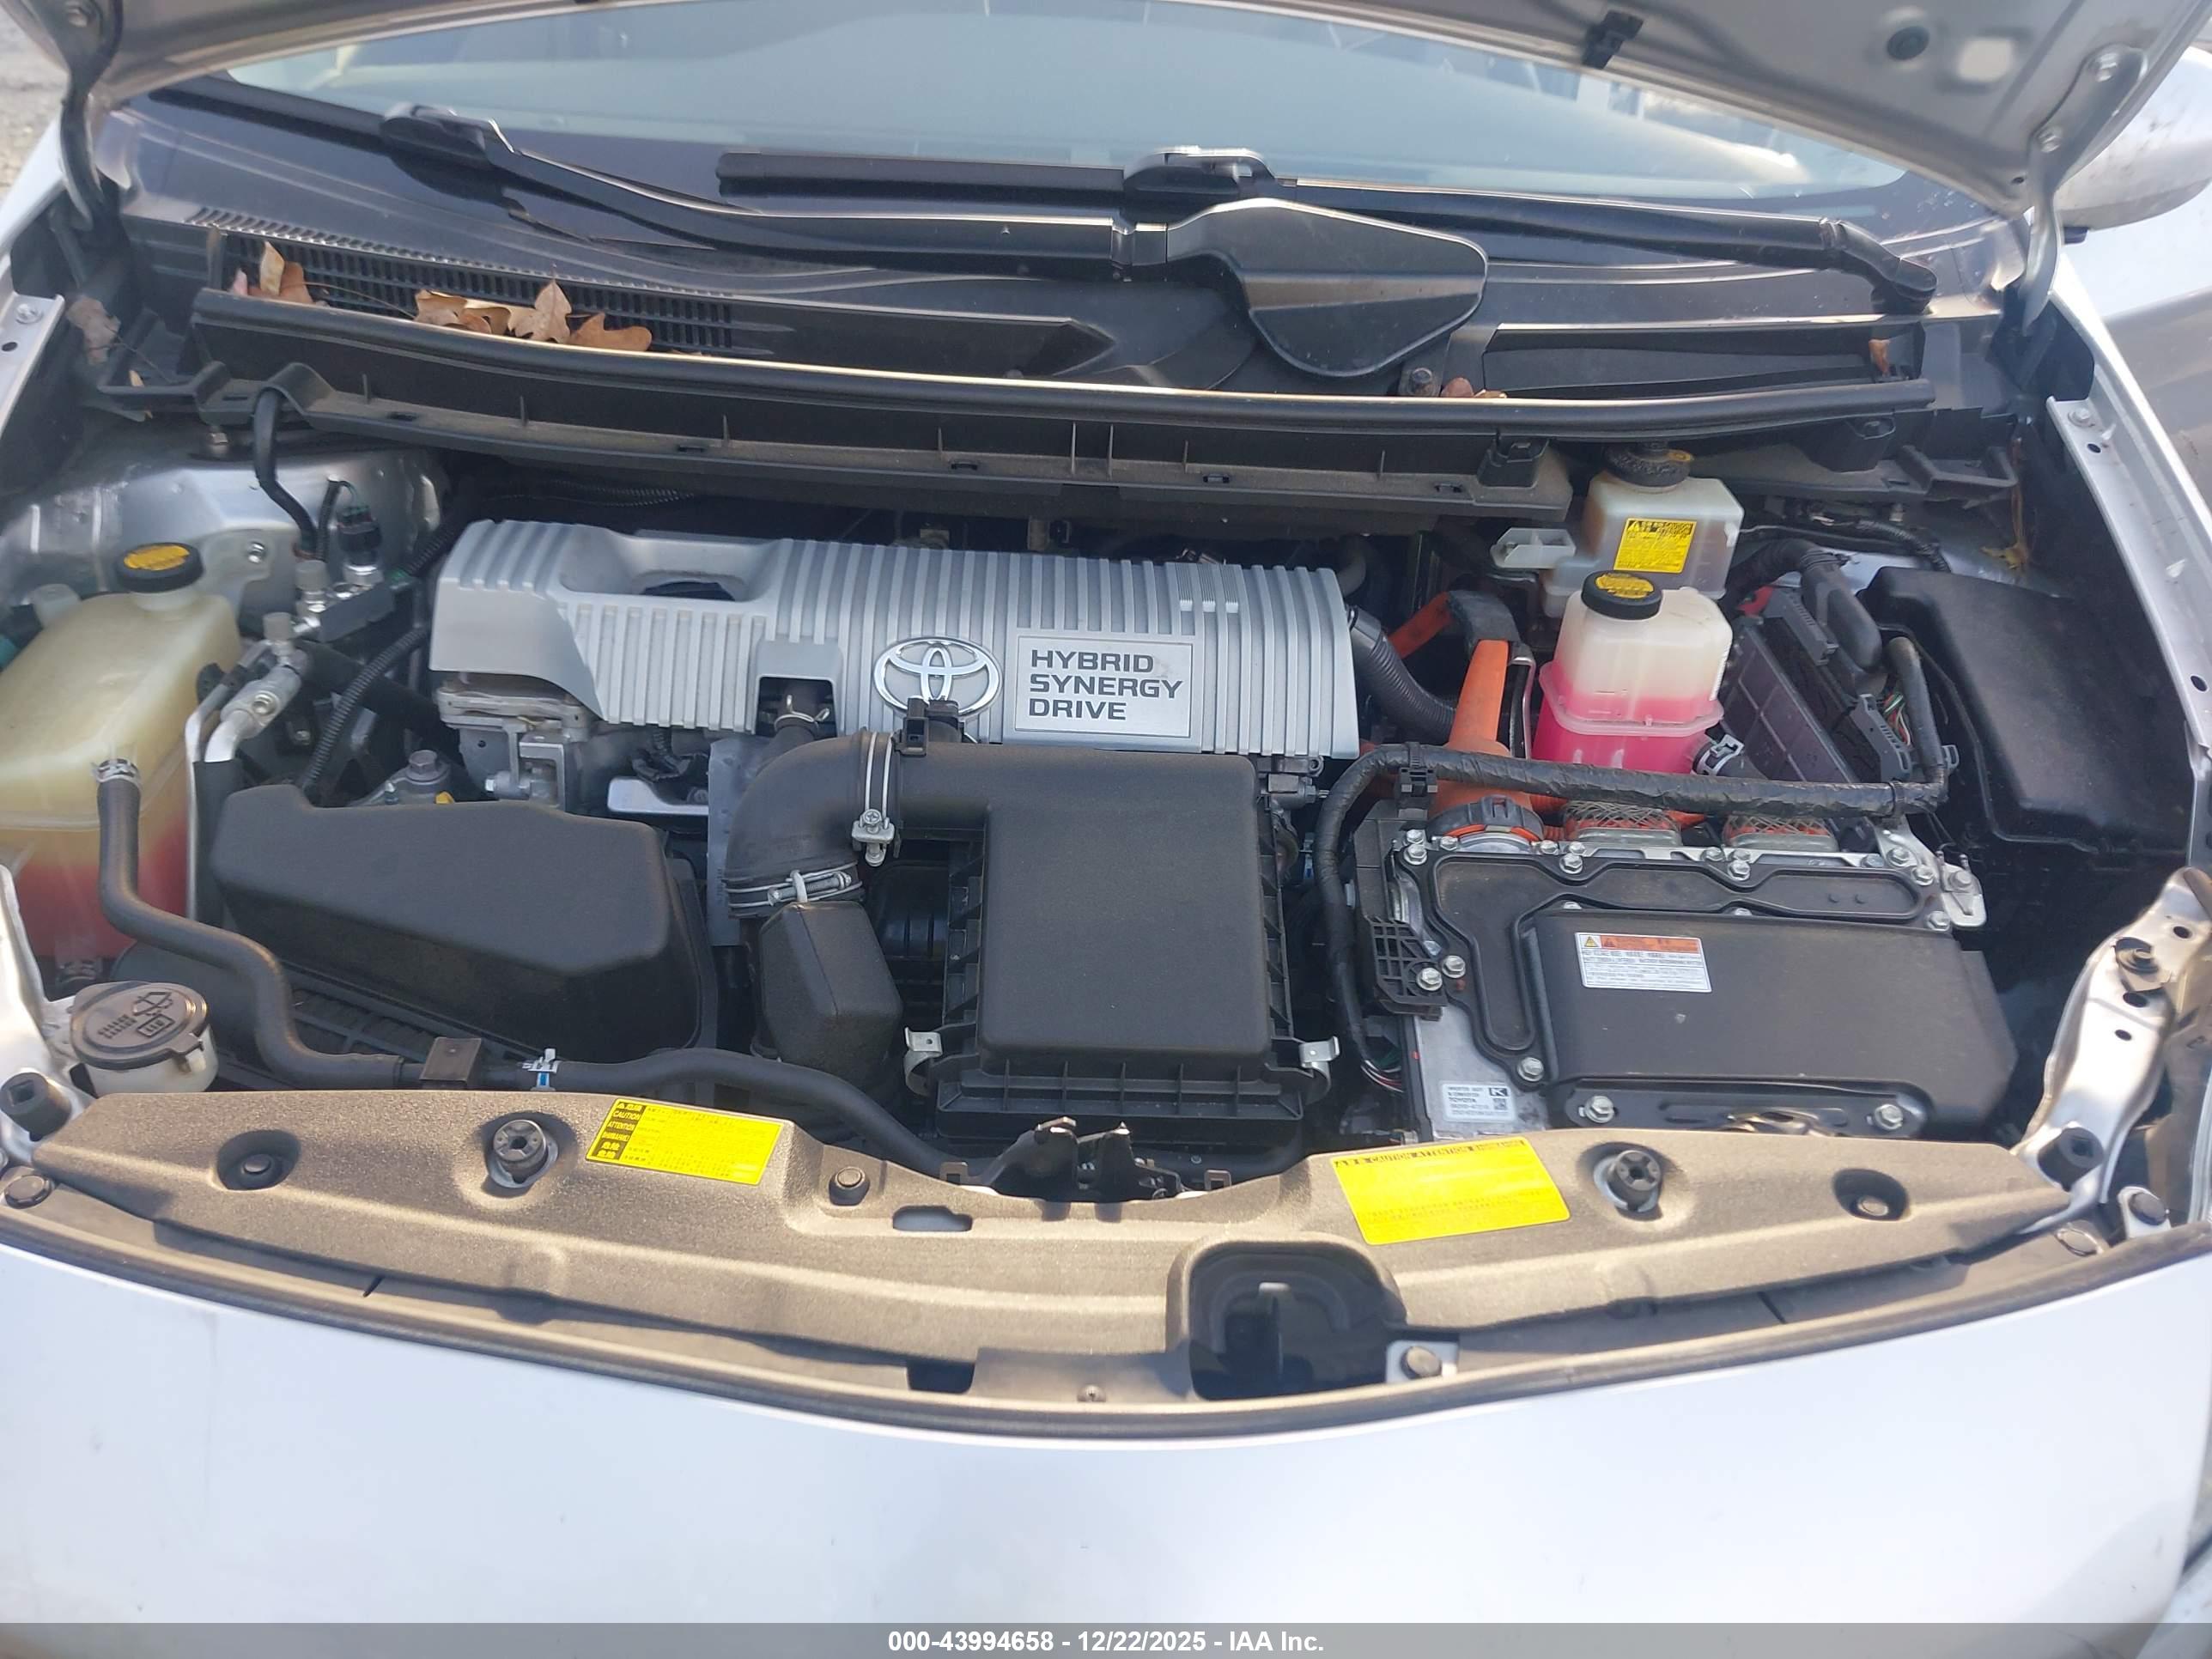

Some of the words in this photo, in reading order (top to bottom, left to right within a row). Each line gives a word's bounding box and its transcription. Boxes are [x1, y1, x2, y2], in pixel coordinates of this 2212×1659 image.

[1031, 649, 1154, 672] HYBRID
[1030, 674, 1183, 698] SYNERGY
[1029, 699, 1127, 720] DRIVE
[612, 1110, 641, 1121] CAUTION
[607, 1121, 636, 1131] ATTENTION
[1371, 1152, 1413, 1163] CAUTION
